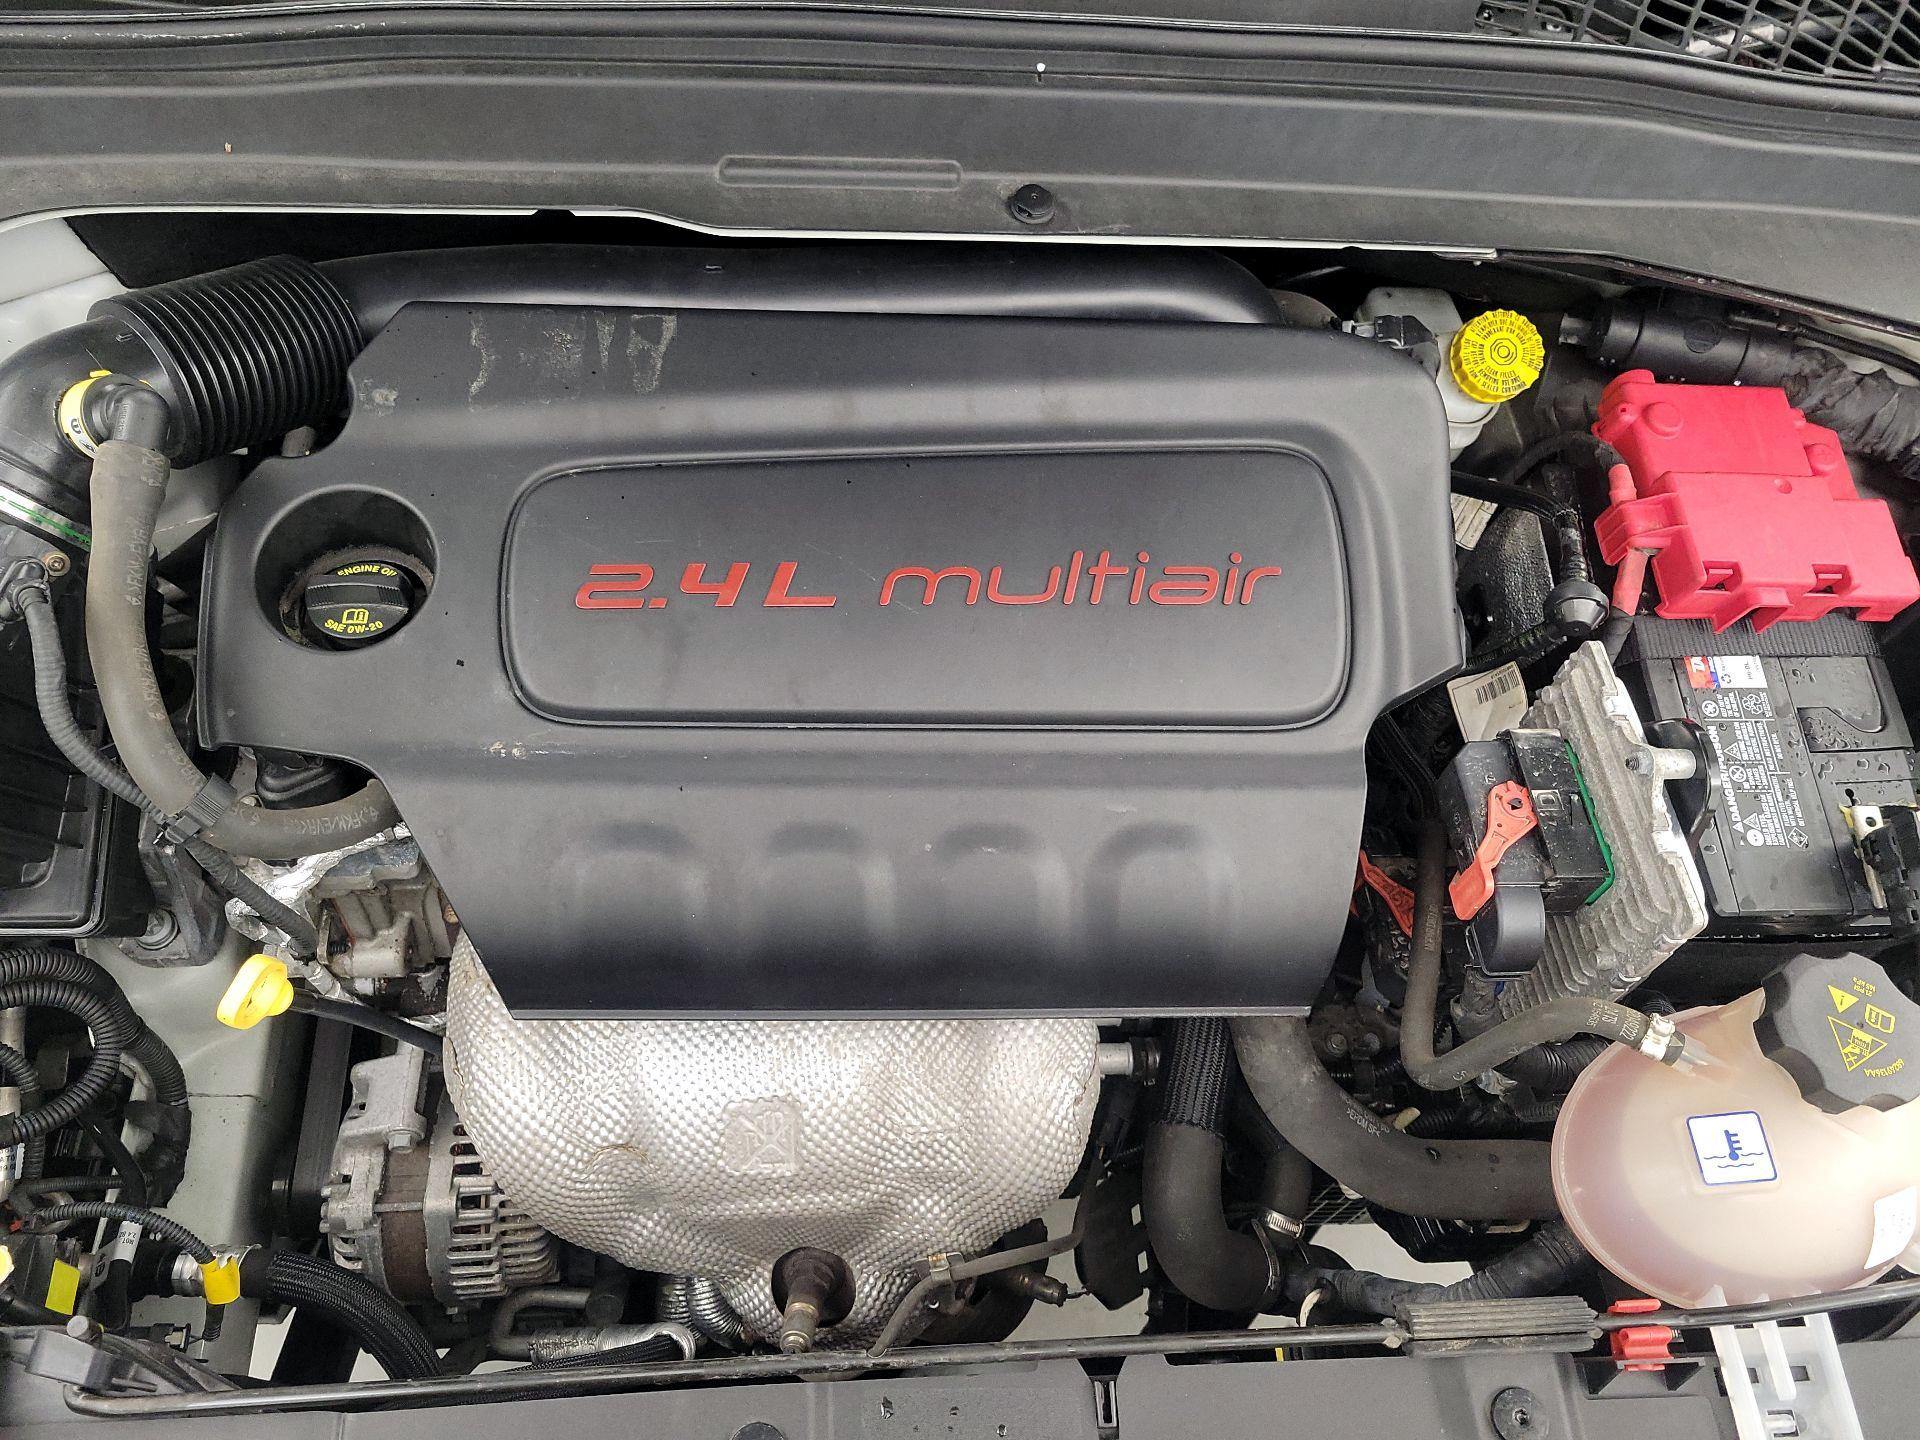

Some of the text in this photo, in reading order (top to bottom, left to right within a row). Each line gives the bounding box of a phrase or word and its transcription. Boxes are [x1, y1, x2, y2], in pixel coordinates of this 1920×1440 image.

[337, 564, 380, 577] ENGINE
[879, 550, 1283, 607] multiair
[324, 619, 383, 634] SAE 0W-20
